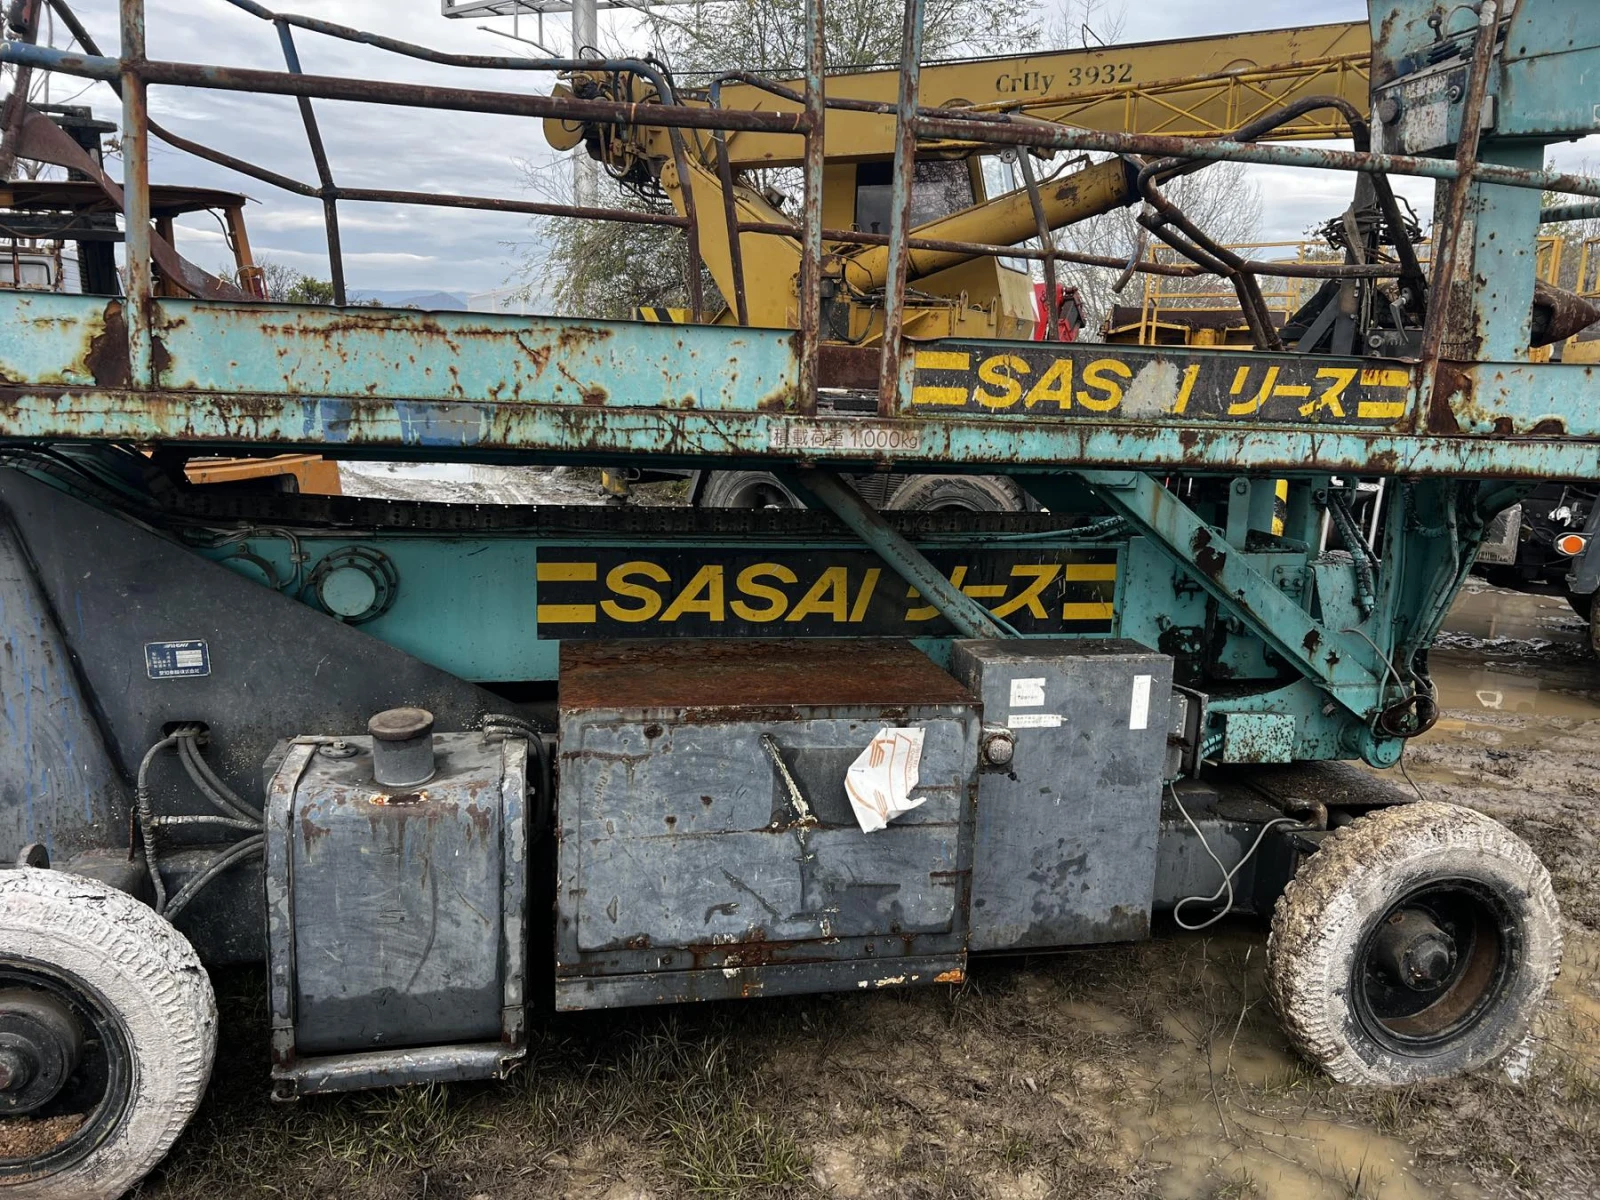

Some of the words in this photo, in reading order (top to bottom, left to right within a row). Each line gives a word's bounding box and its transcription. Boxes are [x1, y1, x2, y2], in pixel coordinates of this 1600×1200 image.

[1068, 63, 1133, 87] 3932
[974, 353, 1201, 415] SASI
[1227, 365, 1358, 419] リース
[600, 561, 881, 623] SASAI
